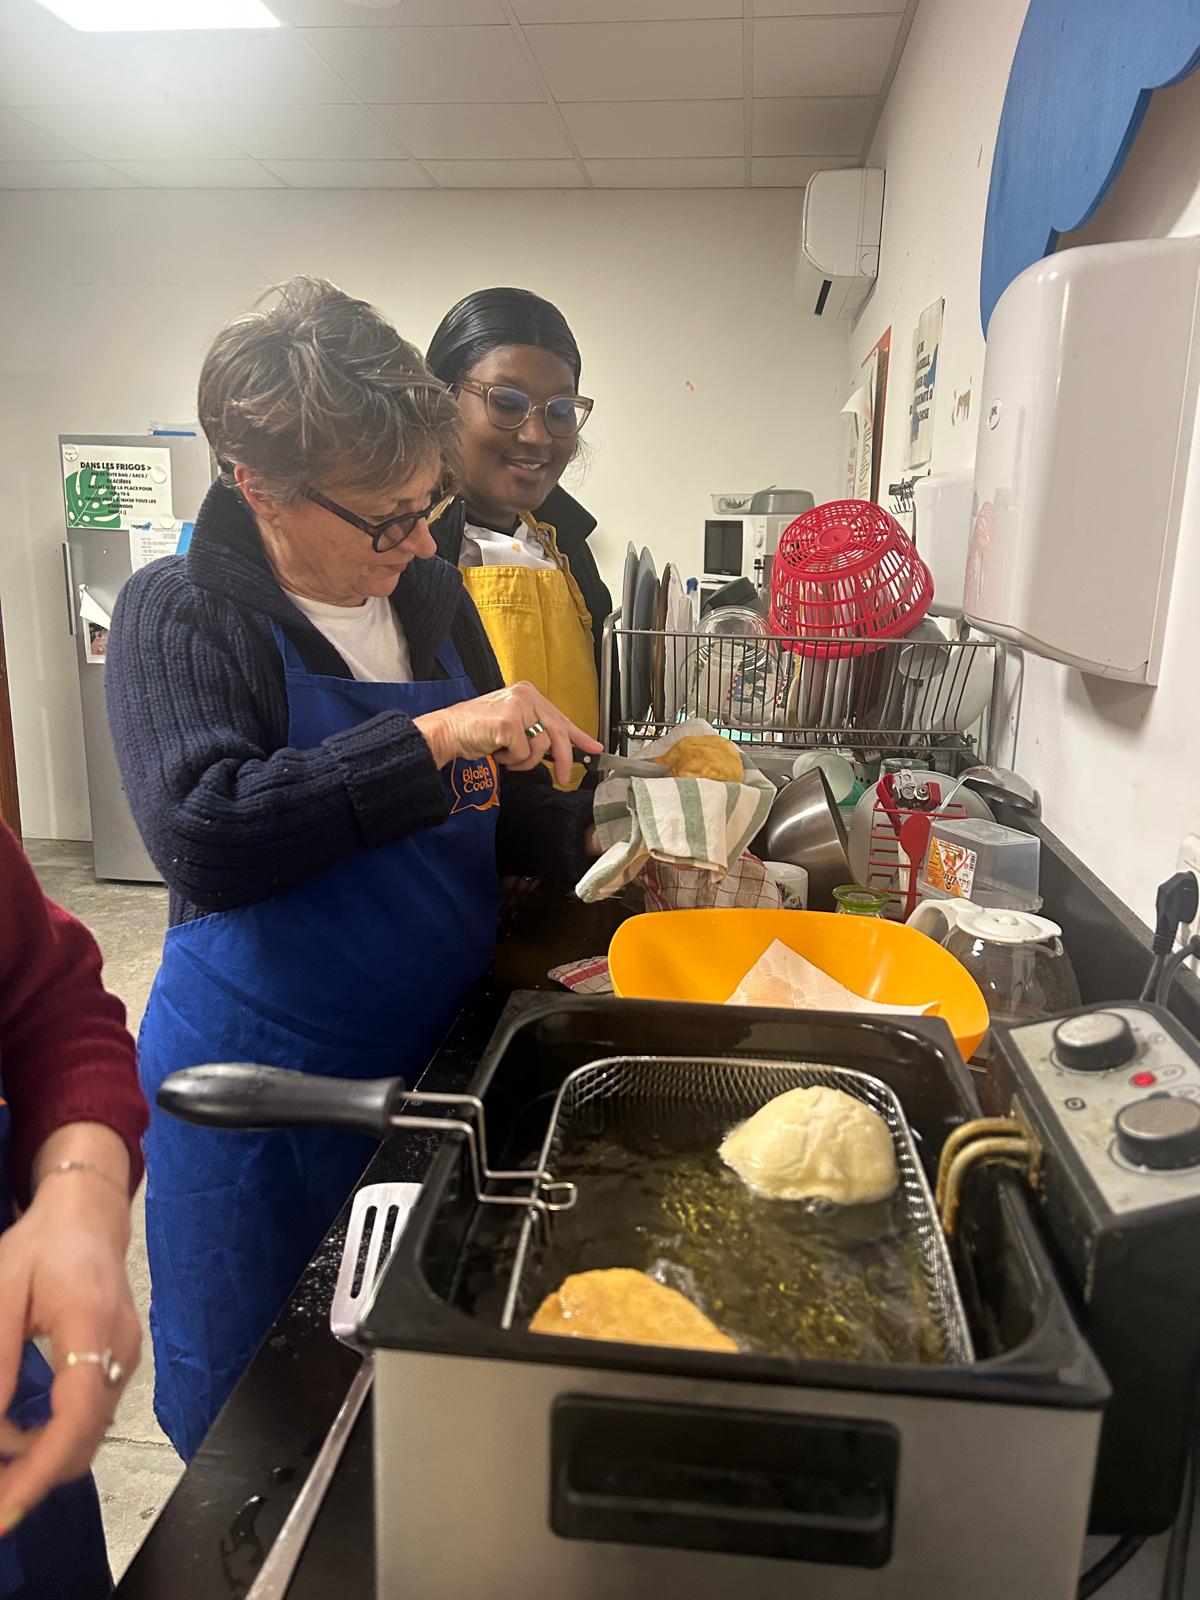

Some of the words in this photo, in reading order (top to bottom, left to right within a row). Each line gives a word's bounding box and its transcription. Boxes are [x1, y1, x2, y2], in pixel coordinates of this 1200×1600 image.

[80, 461, 101, 470] DANS
[101, 462, 115, 470] LES
[115, 462, 146, 471] FRIGOS
[464, 778, 494, 793] Cooks
